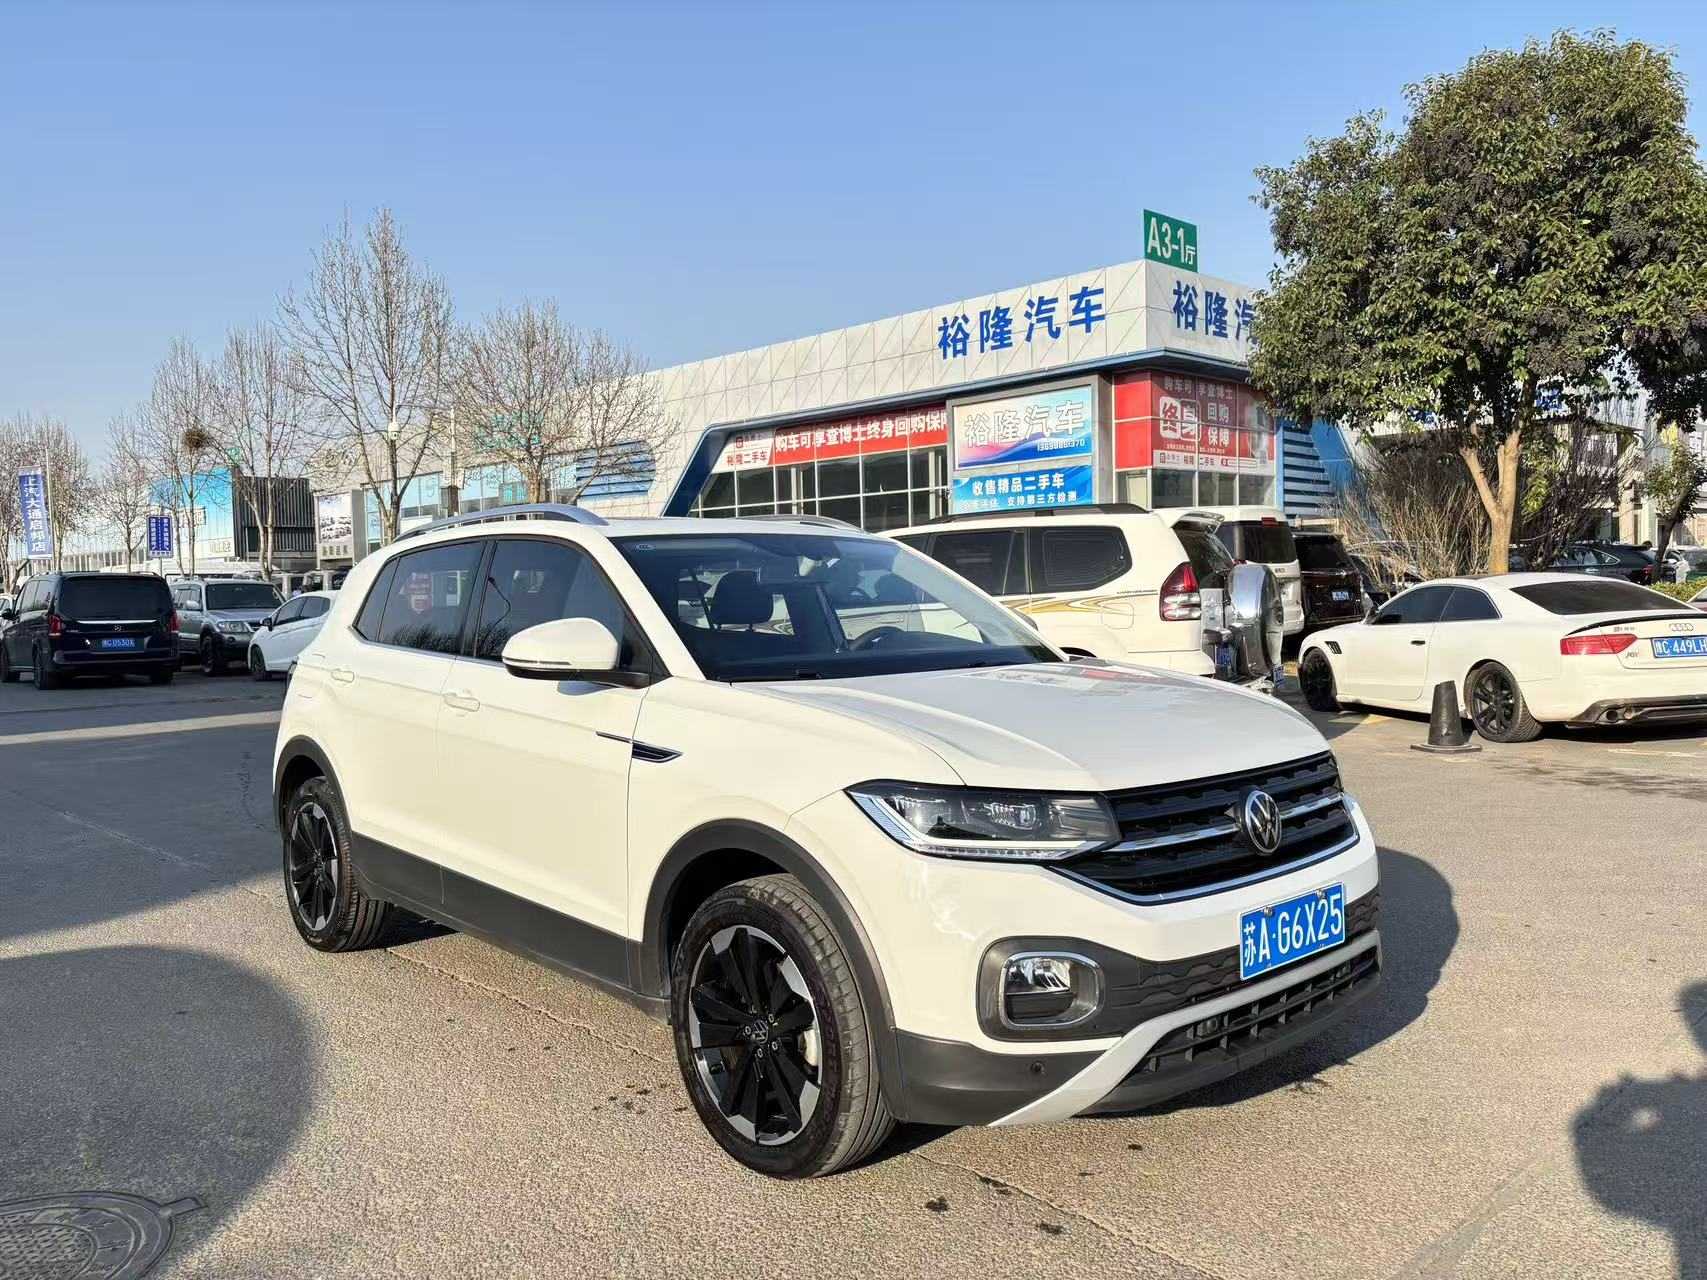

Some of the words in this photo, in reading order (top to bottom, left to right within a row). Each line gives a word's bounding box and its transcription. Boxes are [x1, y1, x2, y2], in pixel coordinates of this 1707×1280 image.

[1147, 216, 1196, 265] A3-1厅
[937, 286, 1106, 360] 裕隆汽车
[965, 400, 1084, 448] 裕隆汽车
[1207, 426, 1229, 449] 保障
